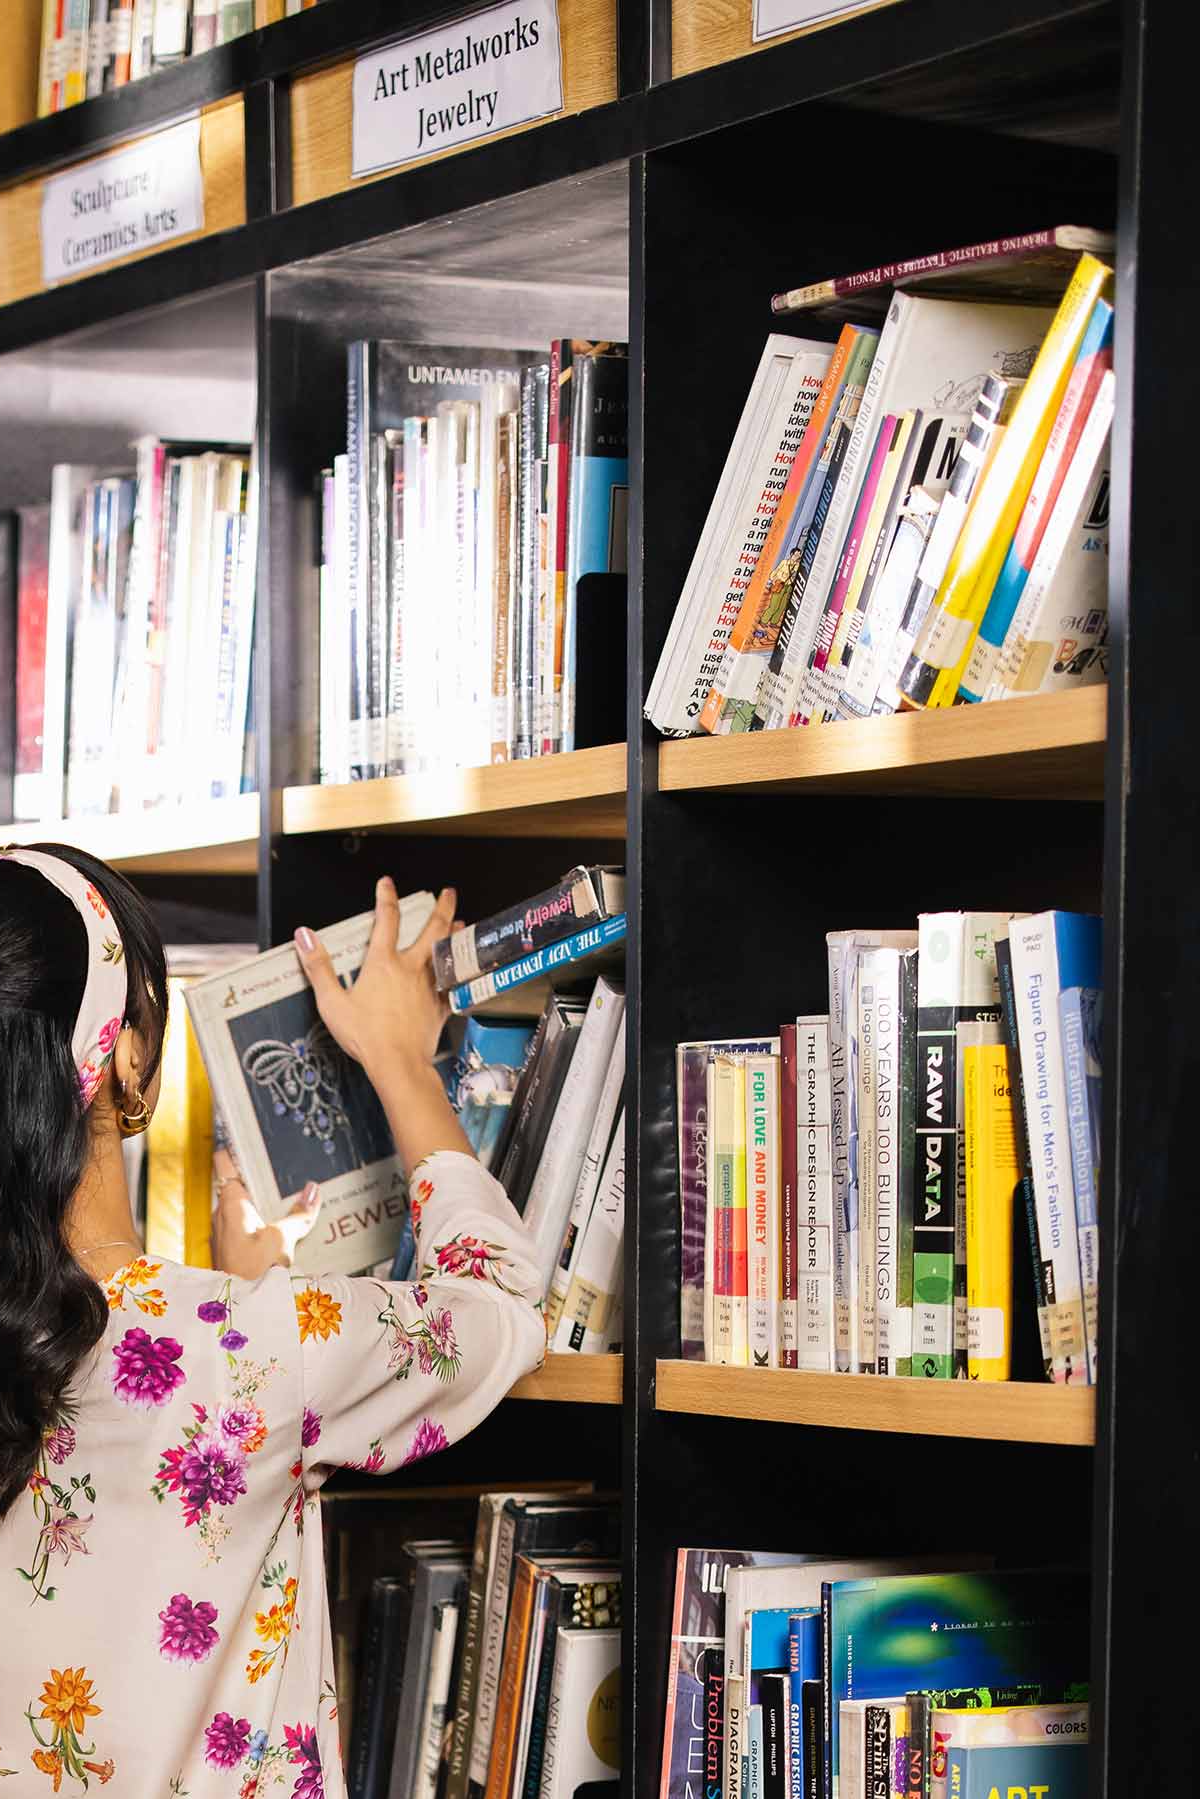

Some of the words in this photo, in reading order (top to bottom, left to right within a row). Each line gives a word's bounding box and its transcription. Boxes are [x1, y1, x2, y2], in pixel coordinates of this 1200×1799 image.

[374, 63, 409, 101] Art
[415, 16, 540, 88] Metalworks
[417, 89, 499, 148] Jewelry
[71, 171, 148, 218] Sculpture
[63, 222, 138, 266] Ceramics
[142, 206, 177, 239] Arts
[949, 239, 1001, 264] REALISTIC
[845, 267, 882, 288] PENCIL
[882, 264, 896, 279] IN
[896, 250, 947, 276] TEXTURES
[796, 390, 819, 401] now
[867, 357, 886, 397] LEAD
[793, 402, 809, 414] the
[783, 427, 805, 440] with
[840, 402, 874, 487] POISONING
[769, 466, 788, 478] run
[816, 479, 834, 529] COMIC
[803, 530, 819, 568] BOOK
[789, 573, 807, 611] FILM
[776, 613, 796, 654] STYLE
[822, 608, 840, 653] MOME
[524, 892, 574, 929] jewelry
[547, 946, 573, 967] NEW
[576, 928, 603, 952] THE
[494, 954, 545, 990] JEWELRY
[832, 966, 841, 990] Anna
[833, 992, 842, 1025] Gerber
[877, 995, 891, 1034] 100
[1027, 974, 1043, 1026] Figure
[807, 1032, 816, 1067] THE
[861, 1007, 874, 1095] logolounge
[1031, 1030, 1049, 1102] Drawing
[752, 1071, 766, 1103] FOR
[877, 1041, 892, 1118] YEARS
[926, 1045, 944, 1124] RAW
[807, 1068, 817, 1141] GRAPHIC
[1040, 1103, 1053, 1129] for
[753, 1106, 767, 1146] LOVE
[877, 1126, 891, 1165] 100
[755, 1151, 767, 1185] AND
[807, 1143, 817, 1204] DESIGN
[1042, 1132, 1058, 1180] Men's
[924, 1135, 943, 1222] DATA
[754, 1189, 768, 1246] MONEY
[877, 1174, 892, 1300] BUILDINGS
[1046, 1184, 1063, 1250] Fashion
[807, 1206, 817, 1269] READER
[473, 1608, 506, 1736] Jewellery
[789, 1633, 800, 1673] LANDA
[550, 1690, 562, 1738] NEW
[706, 1673, 725, 1782] Problem
[791, 1703, 802, 1756] GRAPHIC
[1044, 1722, 1088, 1736] COLORS
[751, 1739, 759, 1789] GRAPHIC
[872, 1727, 888, 1778] Print
[881, 1757, 889, 1775] The
[910, 1748, 923, 1785] NO
[949, 1763, 961, 1792] ART
